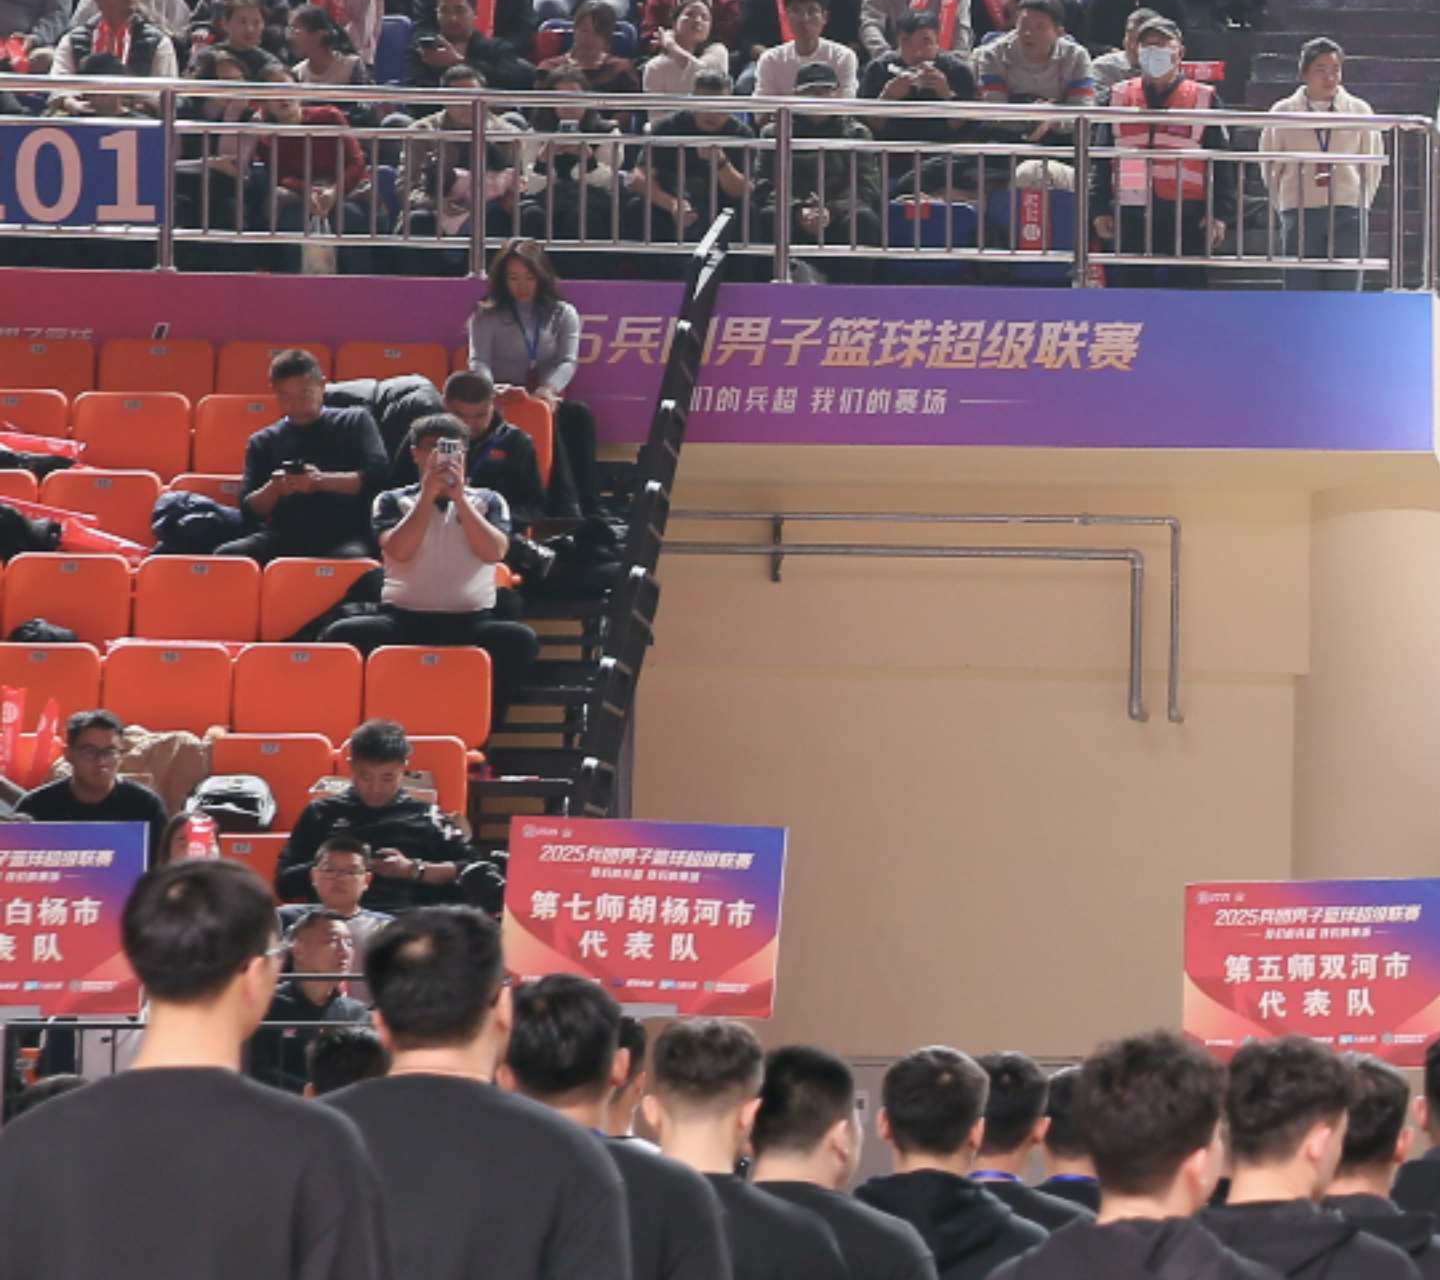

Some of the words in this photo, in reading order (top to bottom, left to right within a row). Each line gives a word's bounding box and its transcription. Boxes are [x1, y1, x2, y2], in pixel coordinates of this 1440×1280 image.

[0, 128, 156, 222] 01
[810, 386, 948, 416] 我们的赛场
[5, 896, 102, 928] 白杨市
[529, 889, 756, 929] 第七师胡杨河市
[579, 929, 699, 961] 代表队
[1224, 951, 1411, 985] 第五师双河市
[1258, 988, 1375, 1019] 代表队
